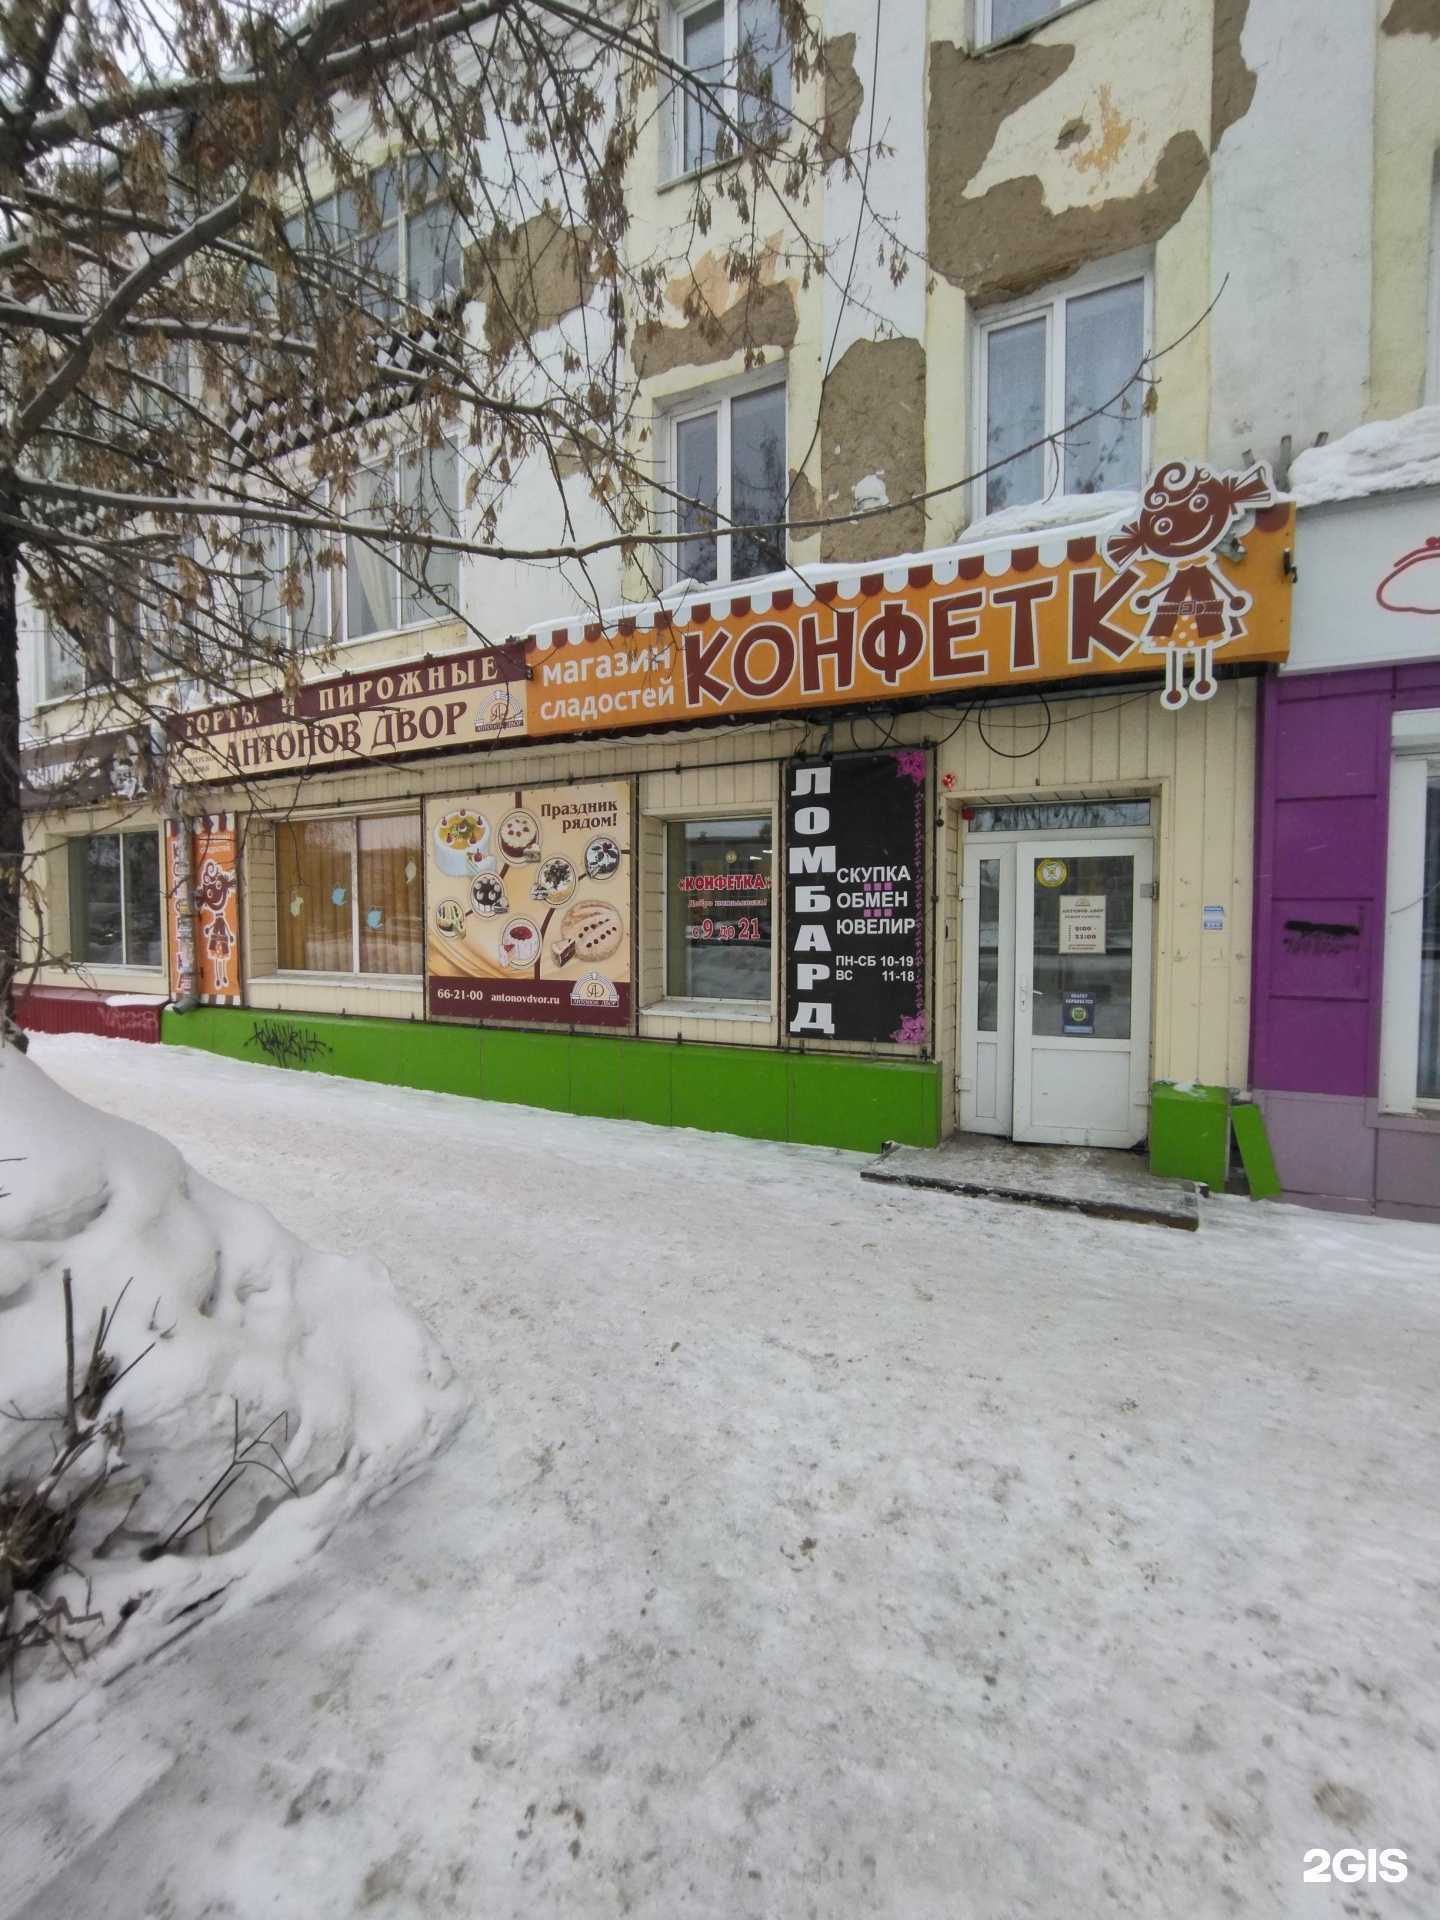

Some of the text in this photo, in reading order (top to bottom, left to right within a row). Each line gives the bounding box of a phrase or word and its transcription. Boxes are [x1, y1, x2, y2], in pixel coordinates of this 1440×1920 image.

[542, 645, 671, 687] магазин
[319, 655, 498, 712] ПИРОЖНЫЕ
[540, 676, 675, 721] сладостей
[226, 701, 468, 768] АНТОНОВ ДВОР
[541, 800, 618, 819] Праздник
[562, 813, 617, 833] рядом!
[836, 865, 911, 884] СКУПКА
[789, 766, 836, 1034] ЛОМБАРД
[836, 891, 908, 908] ОБМЕН
[702, 918, 714, 939] 9
[737, 917, 761, 940] 21
[836, 918, 916, 935] ЮВЕЛИР
[836, 955, 914, 967] ПН-СБ 10-19
[836, 970, 915, 982] ВС 11-18
[437, 988, 560, 1005] 66-21-00 antonovdvor.ru
